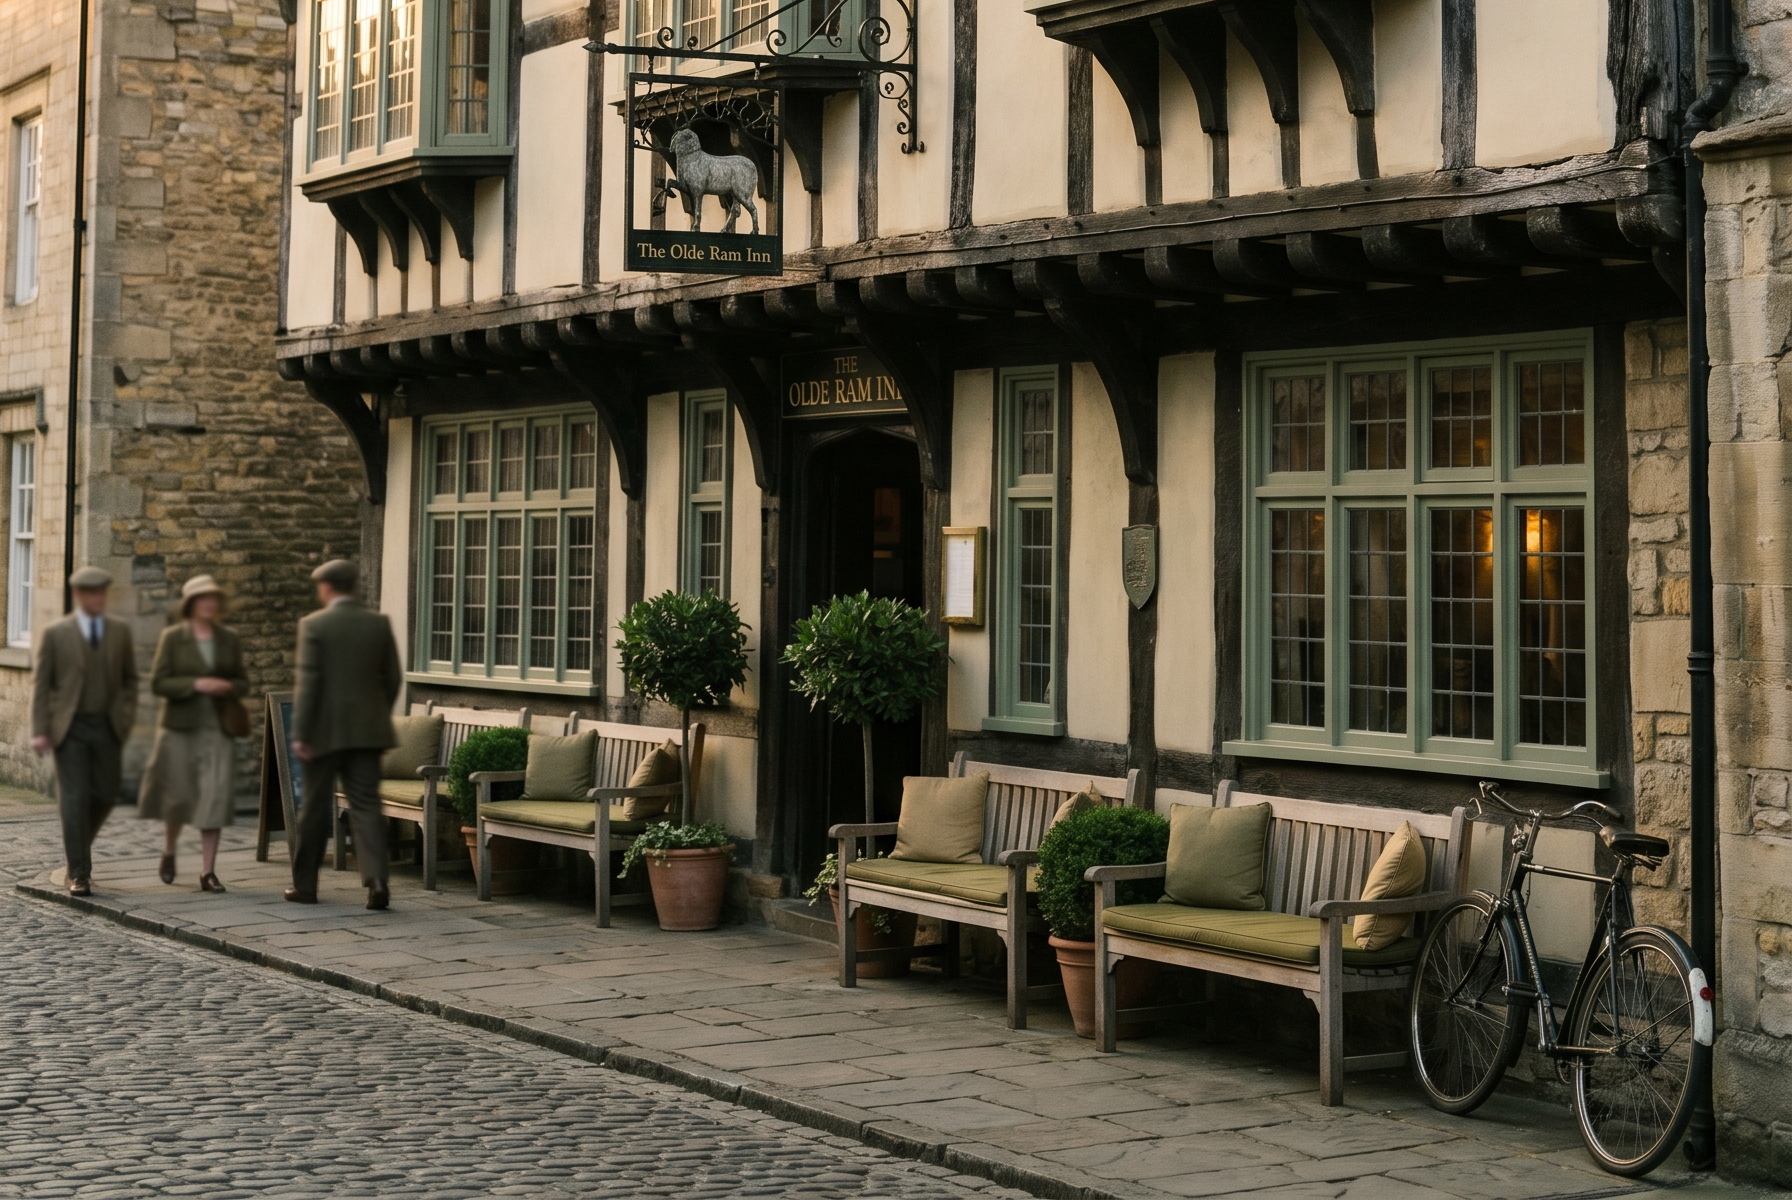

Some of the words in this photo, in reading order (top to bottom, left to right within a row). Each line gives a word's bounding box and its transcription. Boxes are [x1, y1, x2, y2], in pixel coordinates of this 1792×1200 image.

[637, 243, 666, 258] The
[670, 244, 705, 260] Olde
[710, 246, 742, 261] Ram
[746, 247, 771, 263] Inn
[834, 356, 858, 374] THE
[789, 381, 830, 407] OLDE
[835, 376, 872, 404] RAM
[876, 375, 903, 401] IN
